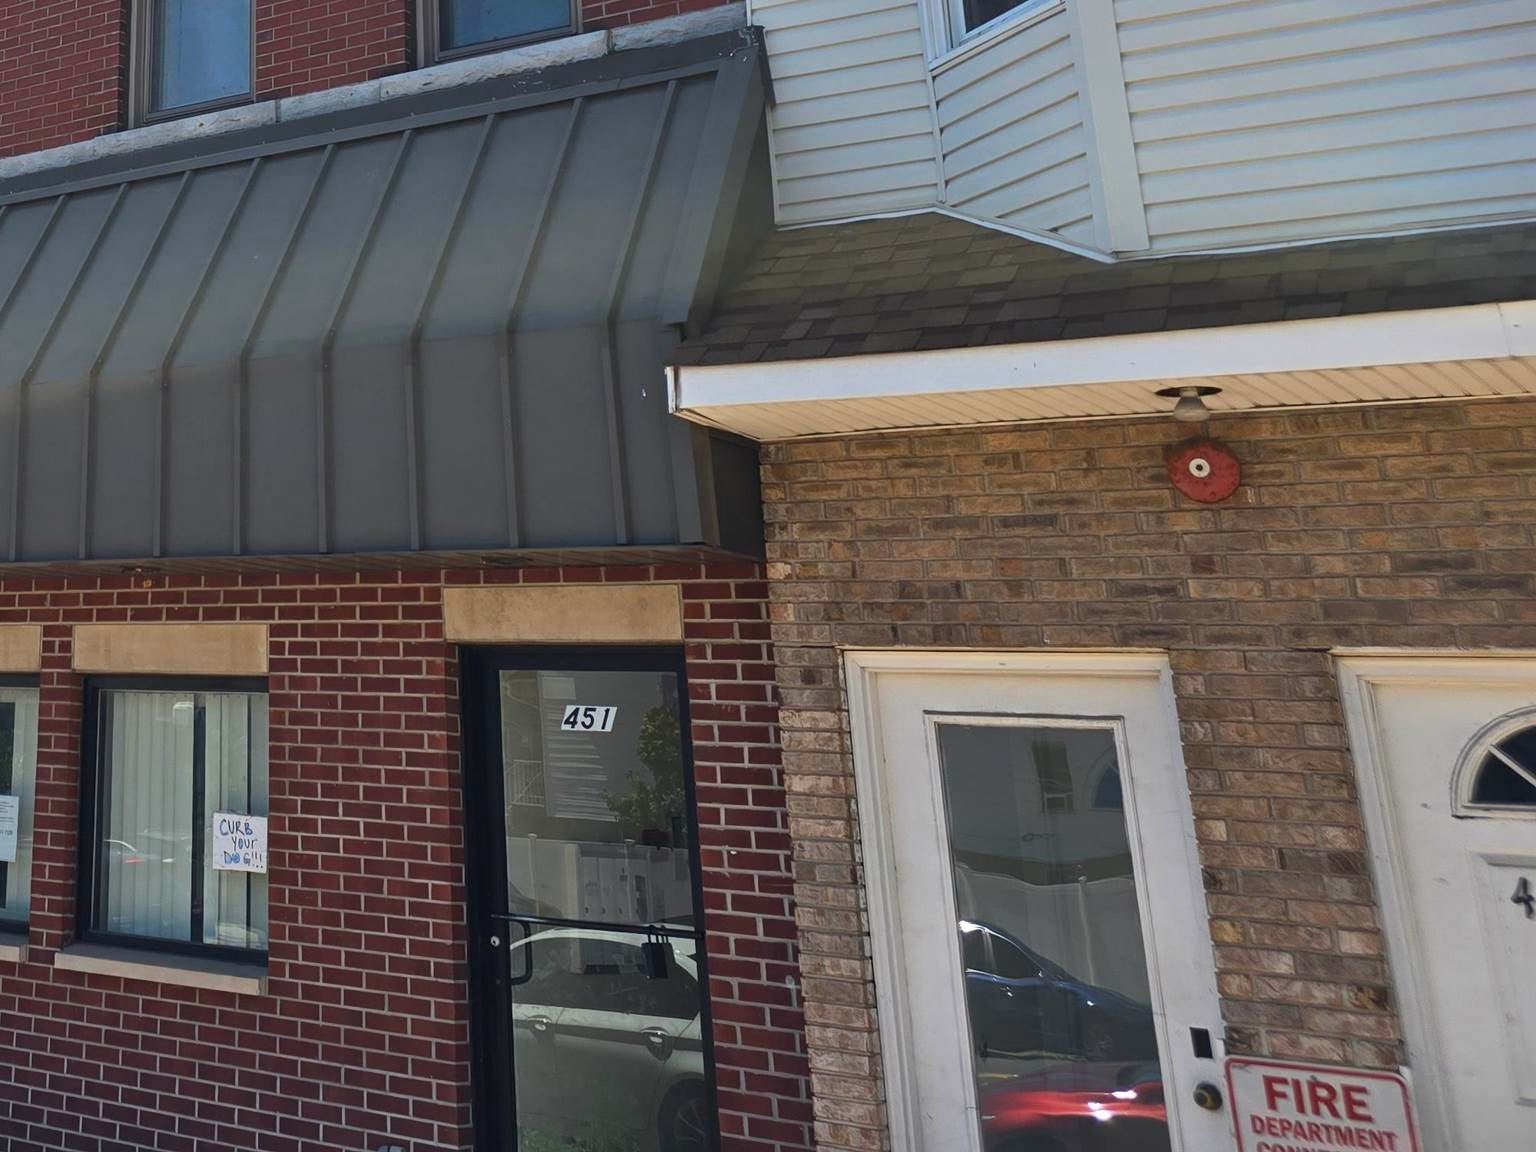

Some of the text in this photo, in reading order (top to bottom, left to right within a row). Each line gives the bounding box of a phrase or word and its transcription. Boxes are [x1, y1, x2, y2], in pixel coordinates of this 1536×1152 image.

[564, 707, 610, 729] 451
[220, 819, 253, 836] CURB
[1262, 1074, 1375, 1123] FIRE
[1249, 1114, 1398, 1151] DEPARTMENT
